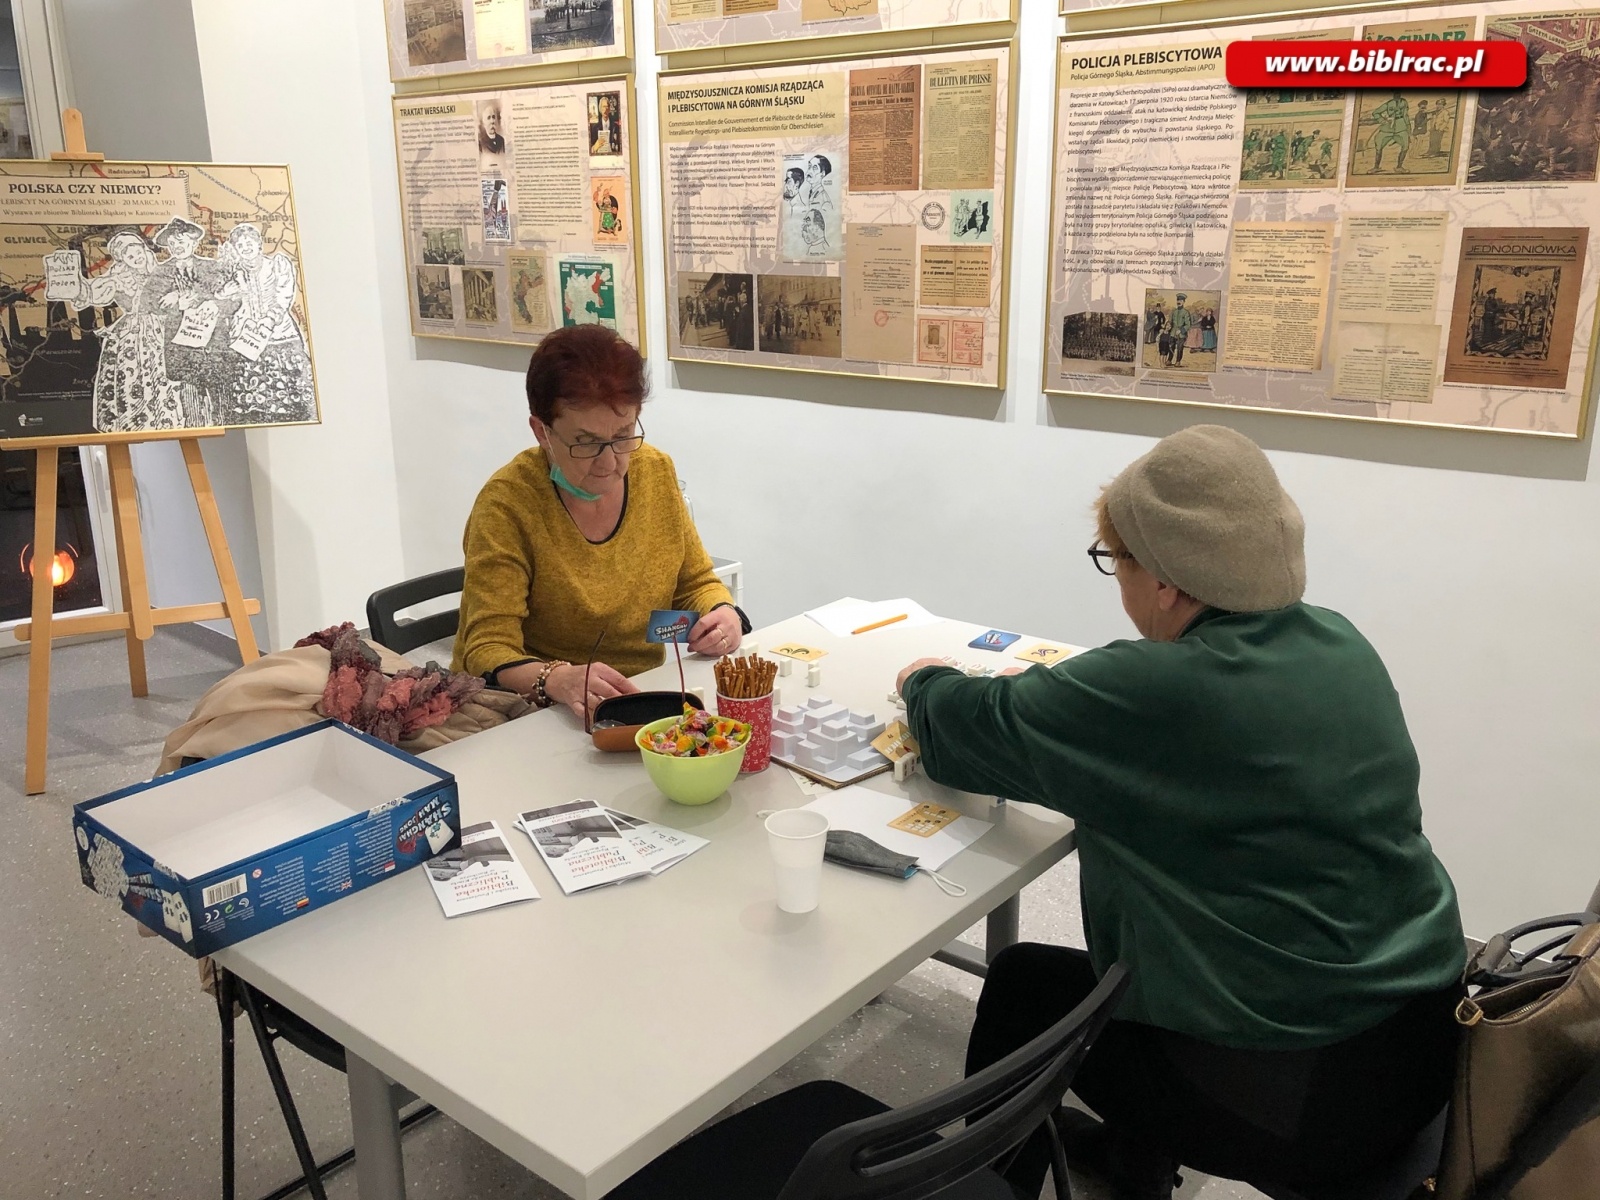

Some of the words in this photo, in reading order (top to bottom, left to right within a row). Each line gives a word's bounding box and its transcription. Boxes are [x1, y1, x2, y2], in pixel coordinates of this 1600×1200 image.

[1071, 55, 1121, 70] POLICJA
[1124, 46, 1222, 66] PLEBISCYTOWA
[1071, 73, 1089, 81] Policja
[1090, 71, 1114, 80] Górnego
[1115, 70, 1134, 78] Śląska,
[1135, 65, 1197, 77] Abstimmungspolizei
[1198, 64, 1216, 72] (APO)
[930, 74, 958, 87] BULLETIN
[668, 87, 744, 102] MIĘDZYSOJUSZNICZA
[745, 83, 779, 94] KOMISJA
[780, 80, 824, 94] RZĄDZĄCA
[668, 105, 671, 113] I
[672, 101, 726, 113] PLEBISCYTOWA
[727, 100, 738, 109] NA
[740, 98, 773, 109] GÓRNYM
[774, 95, 805, 107] ŚLĄSKU
[1210, 104, 1237, 112] Polskiego
[400, 107, 423, 116] TRAKTAT
[424, 106, 456, 115] WERSALSKI
[669, 120, 694, 128] Commission
[724, 117, 759, 125] Gouvernement
[789, 122, 824, 130] Oberschlesien
[1100, 118, 1139, 126] Plebiscytowego
[9, 184, 64, 194] POLSKA
[68, 184, 96, 194] CZY
[100, 185, 162, 195] NIEMCY?
[52, 197, 87, 205] GÓRNYM
[88, 198, 116, 206] ŚLĄSKU
[103, 209, 127, 217] Śląskiej
[214, 211, 249, 220] BĘDZIN
[1467, 245, 1577, 254] JEDNODNIÓWKA
[49, 265, 76, 273] Polska
[185, 316, 209, 328] Polska
[180, 329, 202, 340] Polen
[245, 324, 267, 339] Polska
[239, 336, 259, 350] Polen
[418, 796, 441, 818] MAH
[399, 802, 452, 842] SHANGHAI
[400, 816, 416, 833] JONG
[568, 850, 621, 867] Publiczna
[571, 856, 626, 873] Biblioteka
[454, 874, 509, 890] Publiczna
[456, 880, 514, 897] Biblioteka
